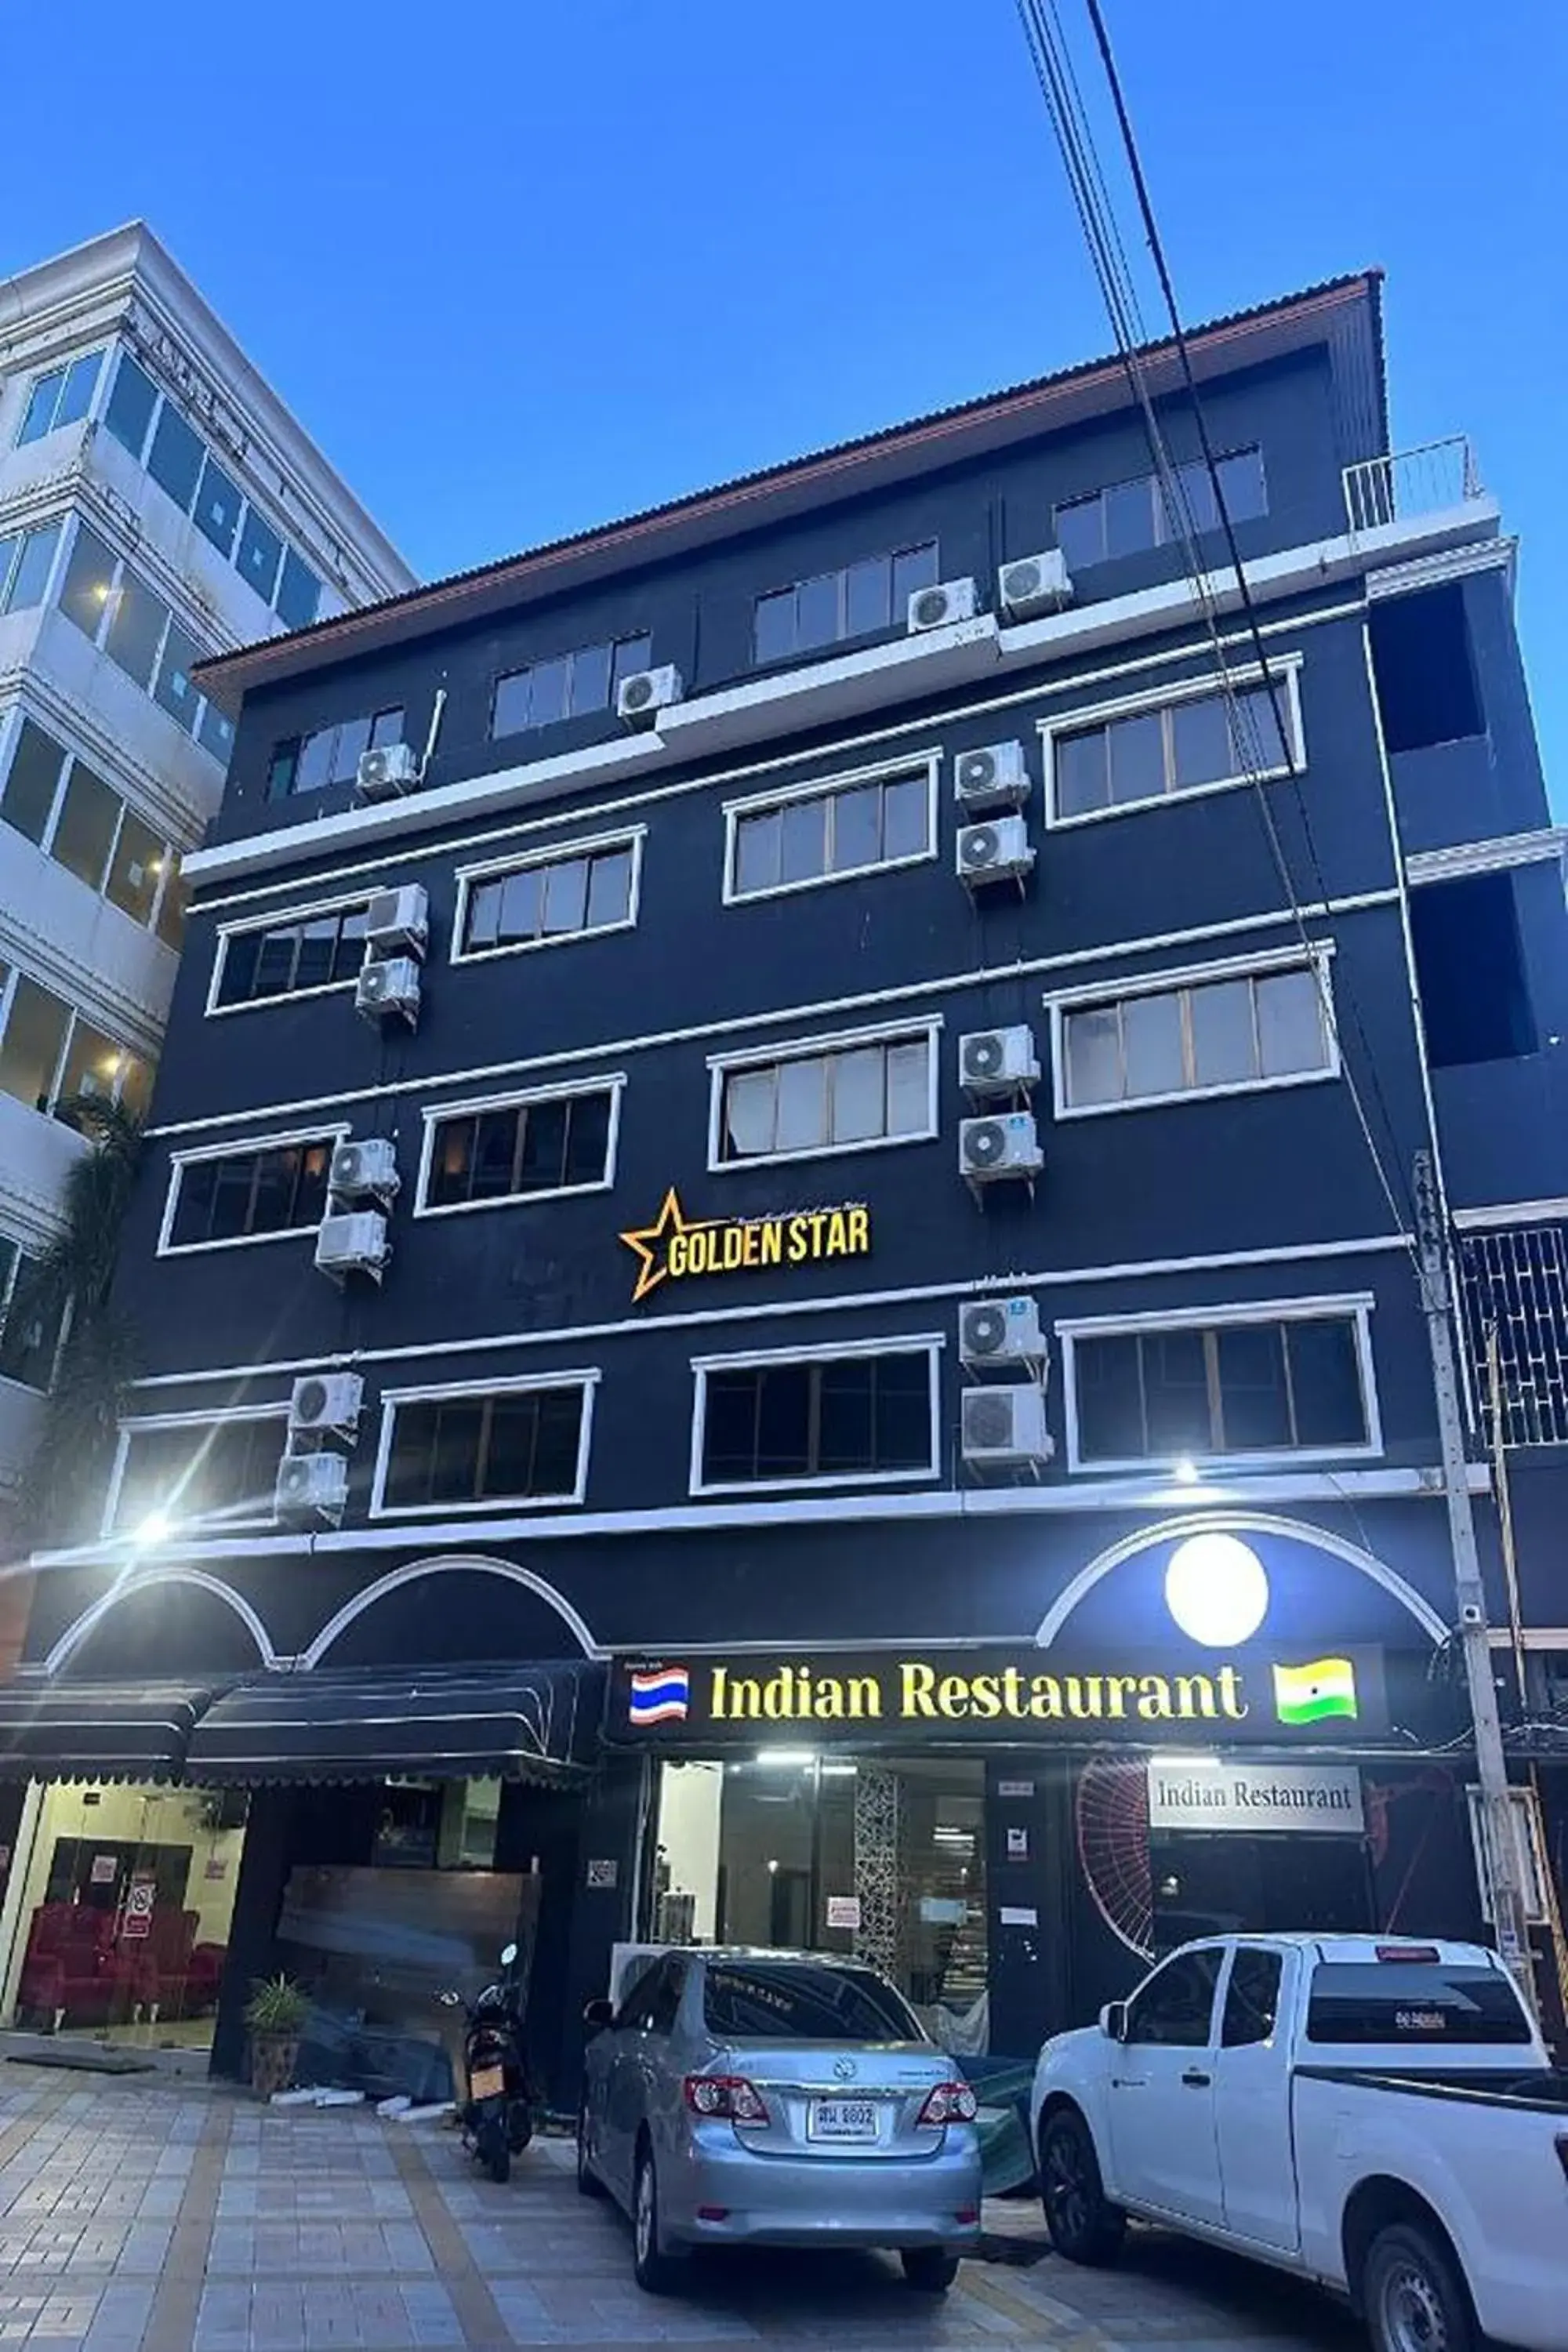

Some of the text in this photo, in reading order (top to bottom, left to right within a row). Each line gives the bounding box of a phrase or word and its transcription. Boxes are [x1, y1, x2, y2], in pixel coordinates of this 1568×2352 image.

[669, 1209, 869, 1276] GOLDEN STAR
[710, 1663, 1249, 1719] Indian Restaurant
[1158, 1780, 1352, 1809] Indian Restaurant
